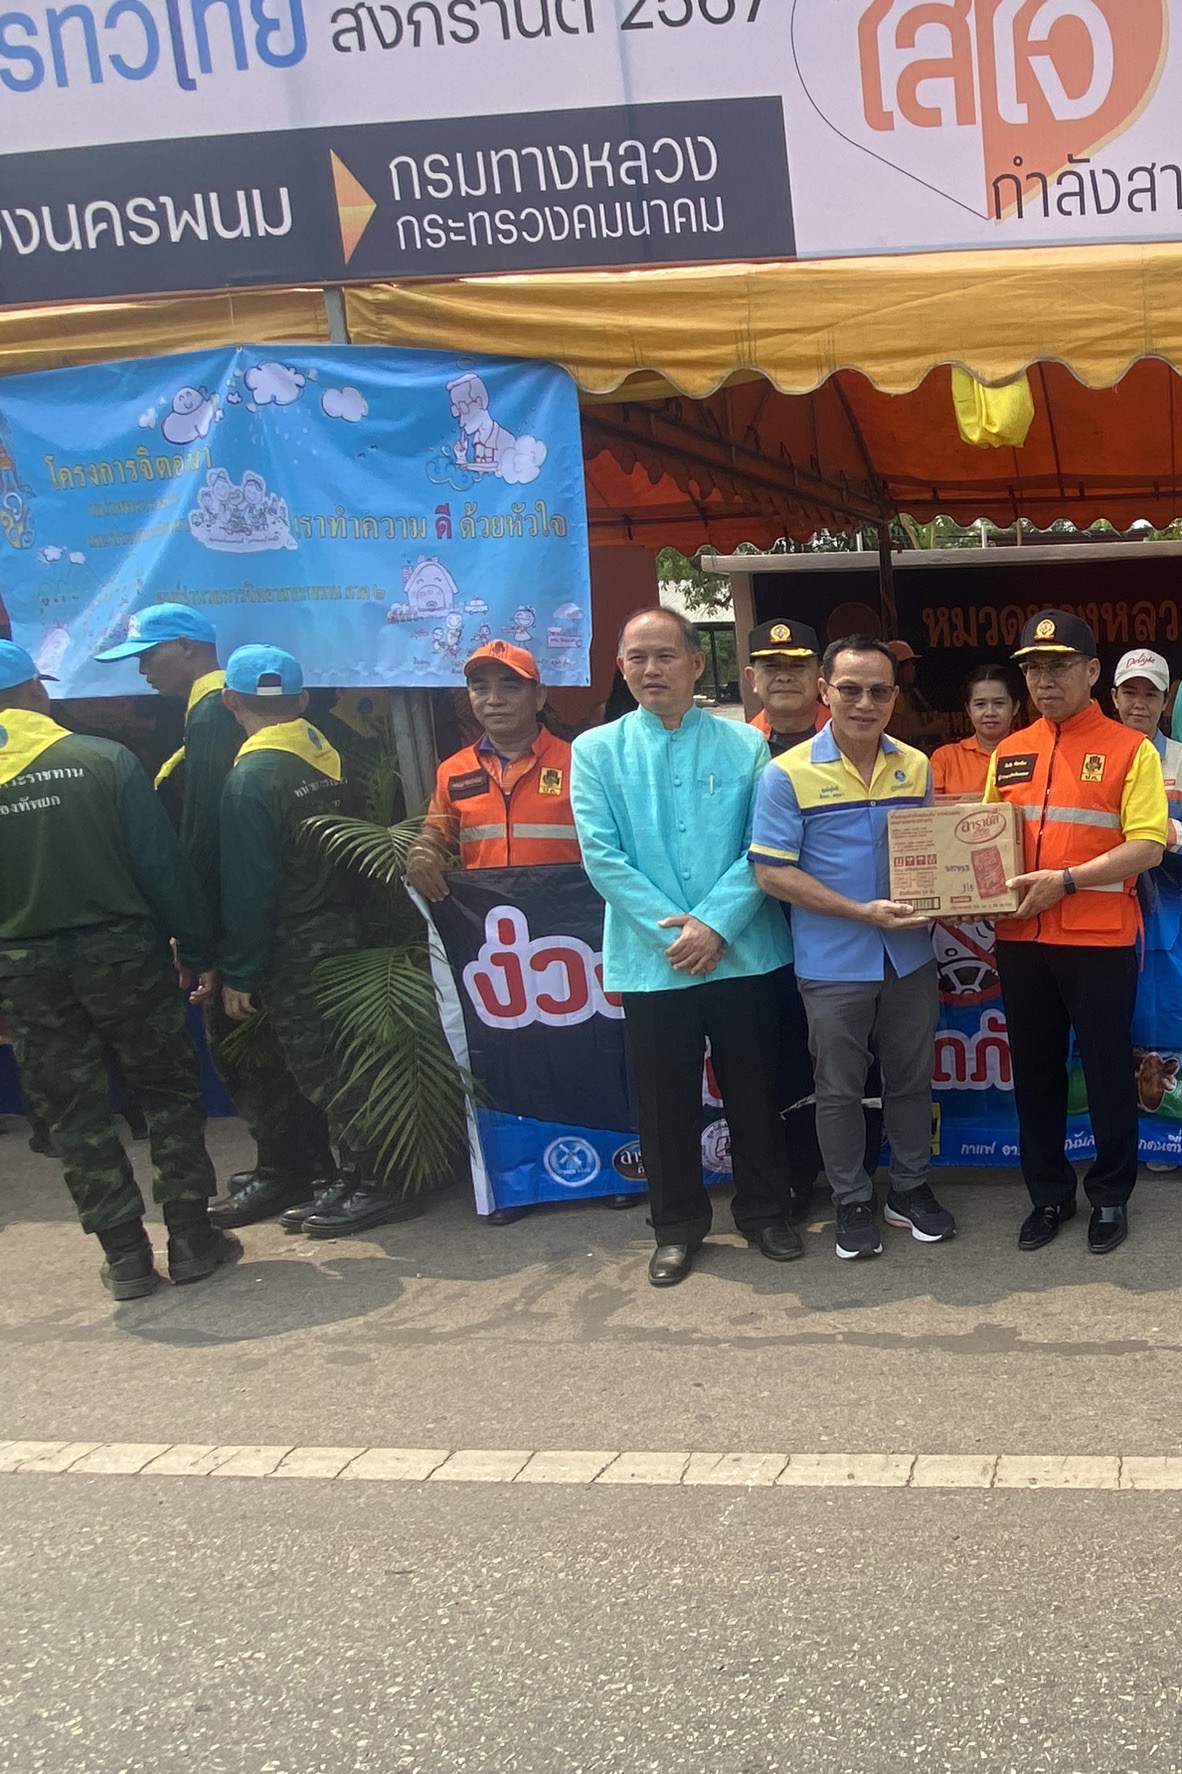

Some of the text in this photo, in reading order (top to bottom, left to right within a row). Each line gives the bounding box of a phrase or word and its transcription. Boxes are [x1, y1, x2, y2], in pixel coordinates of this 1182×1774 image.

[389, 135, 717, 201] กรมทางหลวง
[396, 196, 725, 250] กระทรวงคมนาคม
[0, 767, 84, 788] ระราชทาน
[1002, 1145, 1020, 1156] อา
